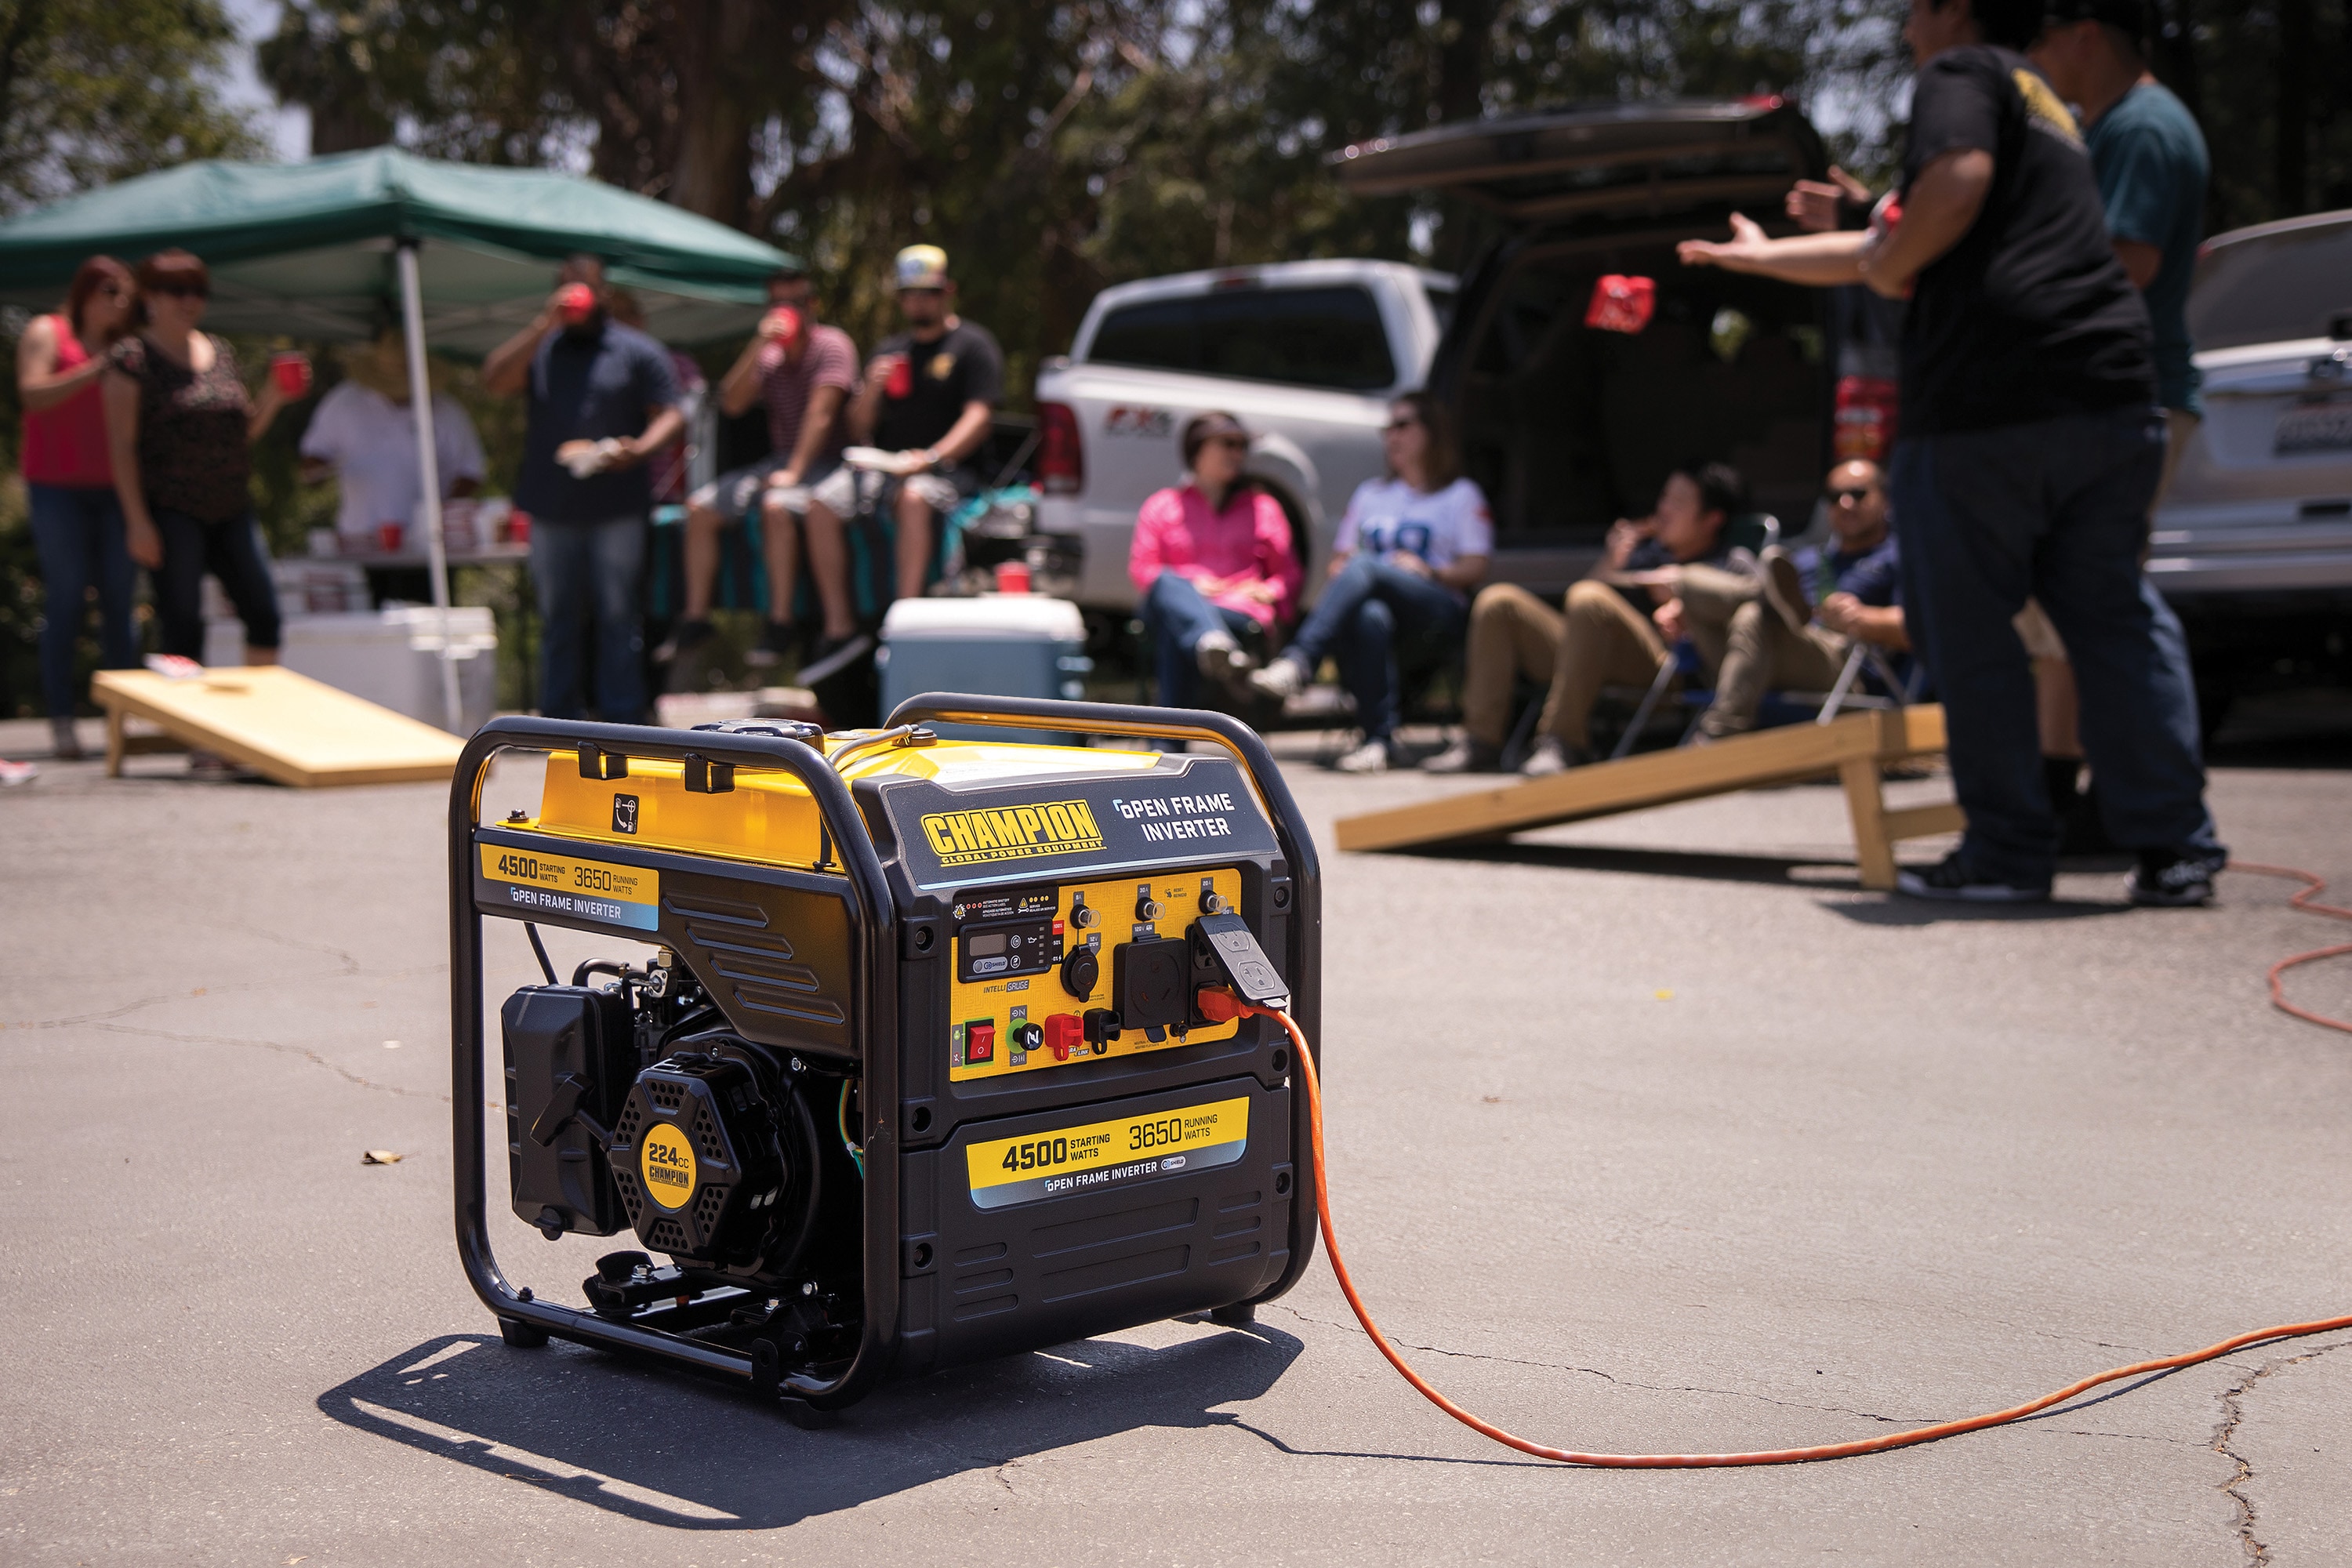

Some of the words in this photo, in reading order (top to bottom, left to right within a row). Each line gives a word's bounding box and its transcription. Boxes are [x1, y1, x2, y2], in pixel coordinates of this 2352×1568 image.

[1173, 792, 1236, 814] FRAME
[931, 800, 1099, 853] CHAMPION
[1141, 817, 1232, 842] INVERTER
[941, 852, 989, 864] GLOBAL
[989, 848, 1033, 858] POWER
[1037, 840, 1103, 854] EQUIPMENT
[498, 854, 538, 880] 4500
[539, 862, 566, 875] STARTING
[574, 866, 612, 891] 3650
[612, 874, 638, 886] RUNNING
[539, 873, 558, 883] WATTS
[613, 884, 633, 895] WATTS
[539, 893, 572, 911] FRAME
[574, 898, 621, 920] INVERTER
[1002, 1137, 1067, 1172] 4500
[1070, 1133, 1111, 1149] STARTING
[1129, 1117, 1181, 1151] 3650
[1184, 1113, 1218, 1129] RUNNING
[1070, 1148, 1099, 1162] WATTS
[1184, 1127, 1210, 1140] WATTS
[648, 1165, 689, 1185] CHAMPION
[1076, 1170, 1109, 1187] FRAME
[1112, 1162, 1158, 1181] INVERTER
